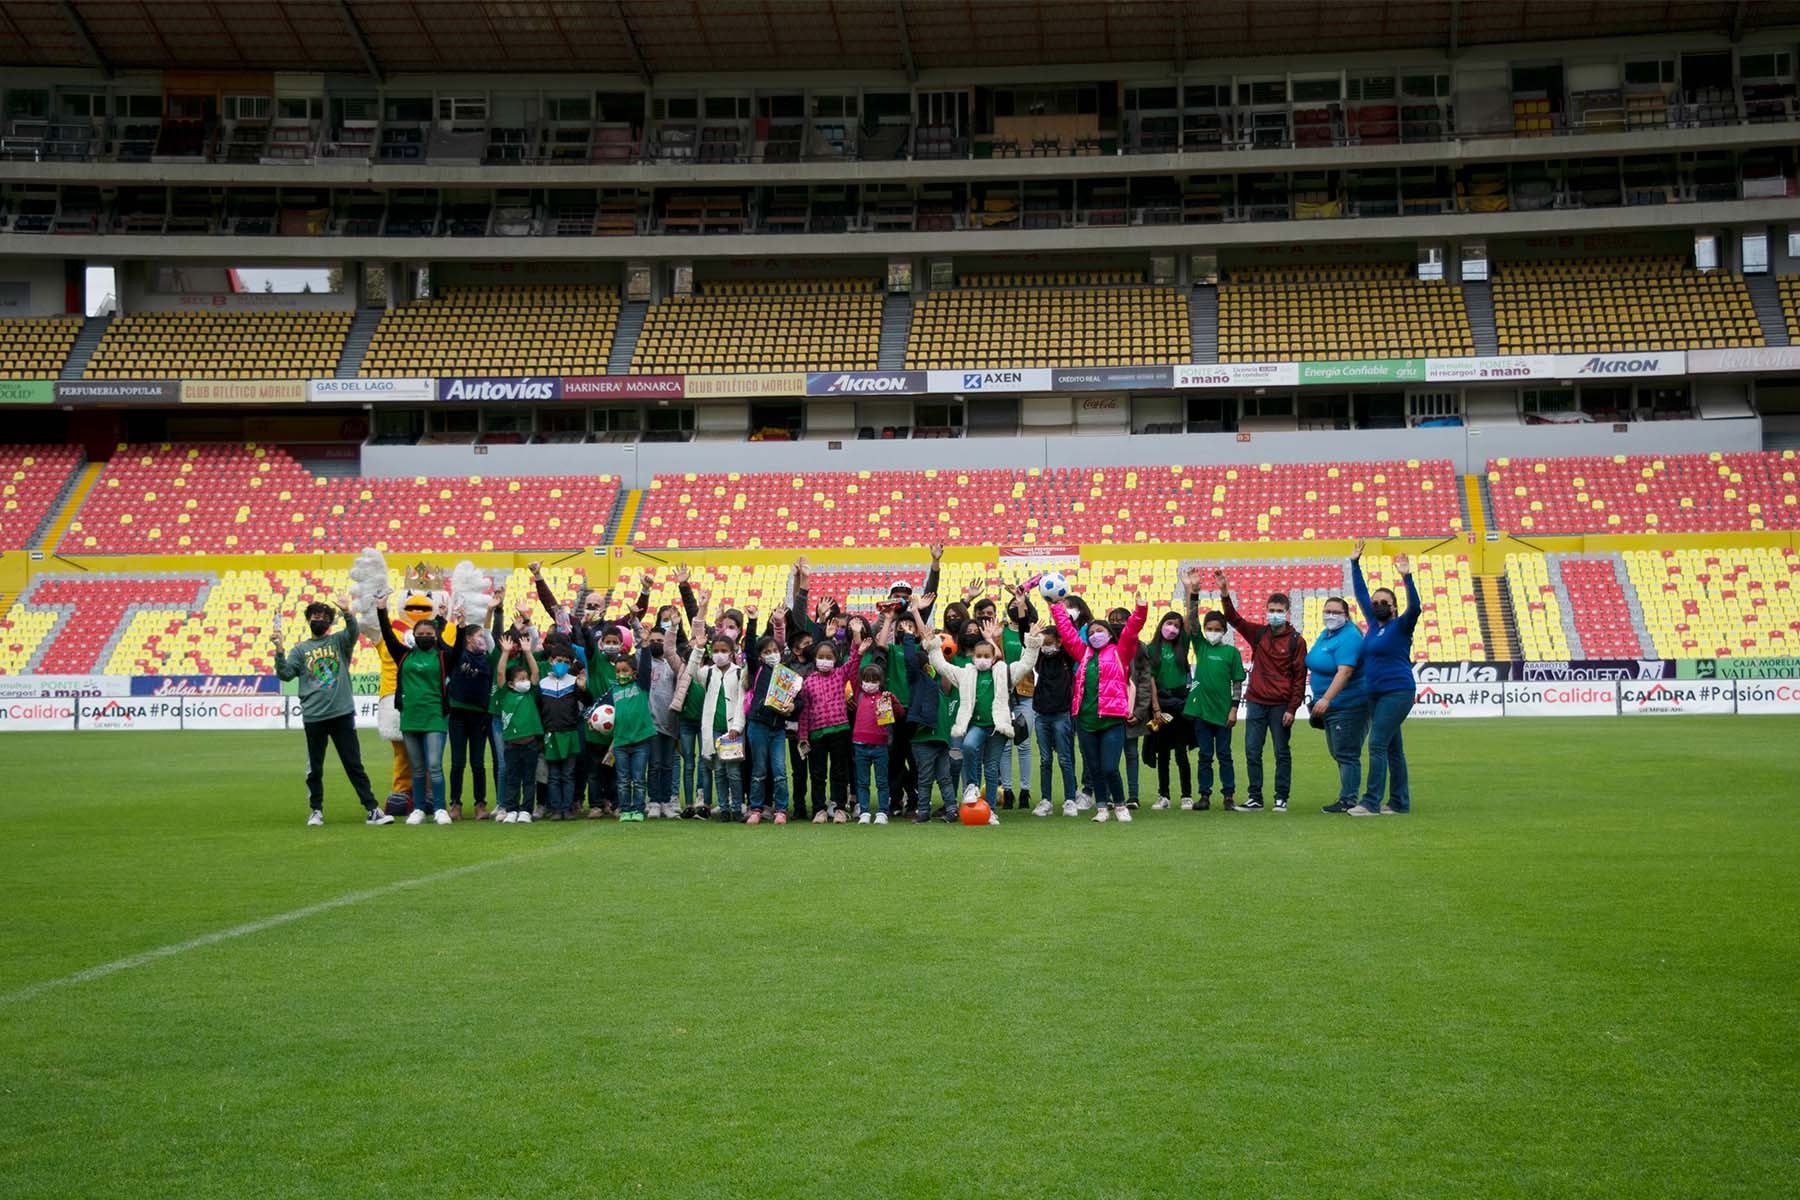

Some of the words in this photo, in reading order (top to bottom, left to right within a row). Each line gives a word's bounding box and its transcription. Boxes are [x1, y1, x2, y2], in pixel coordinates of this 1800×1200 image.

[1343, 364, 1388, 375] Confiable
[1578, 358, 1660, 373] AKRON
[984, 373, 1022, 383] AXEN
[1479, 369, 1489, 377] a
[1491, 368, 1531, 377] mano
[826, 374, 905, 392] AKRON
[1086, 375, 1101, 383] REAL
[1180, 376, 1189, 384] a
[1192, 375, 1230, 384] mano
[120, 386, 162, 395] POPULAR
[186, 385, 209, 398] CLUB
[259, 385, 302, 398] MORELIA
[316, 383, 338, 391] GAS
[341, 382, 361, 390] DEL
[364, 382, 394, 390] LAGO
[446, 378, 554, 400] Autovías
[565, 383, 621, 393] HARINERA
[688, 381, 712, 393] CLUB
[761, 379, 803, 392] MORELIA
[155, 677, 198, 696] Salsa
[41, 689, 50, 698] a
[55, 689, 102, 698] mano
[1624, 690, 1696, 702] CALIDRA
[81, 706, 147, 718] CALIDRA
